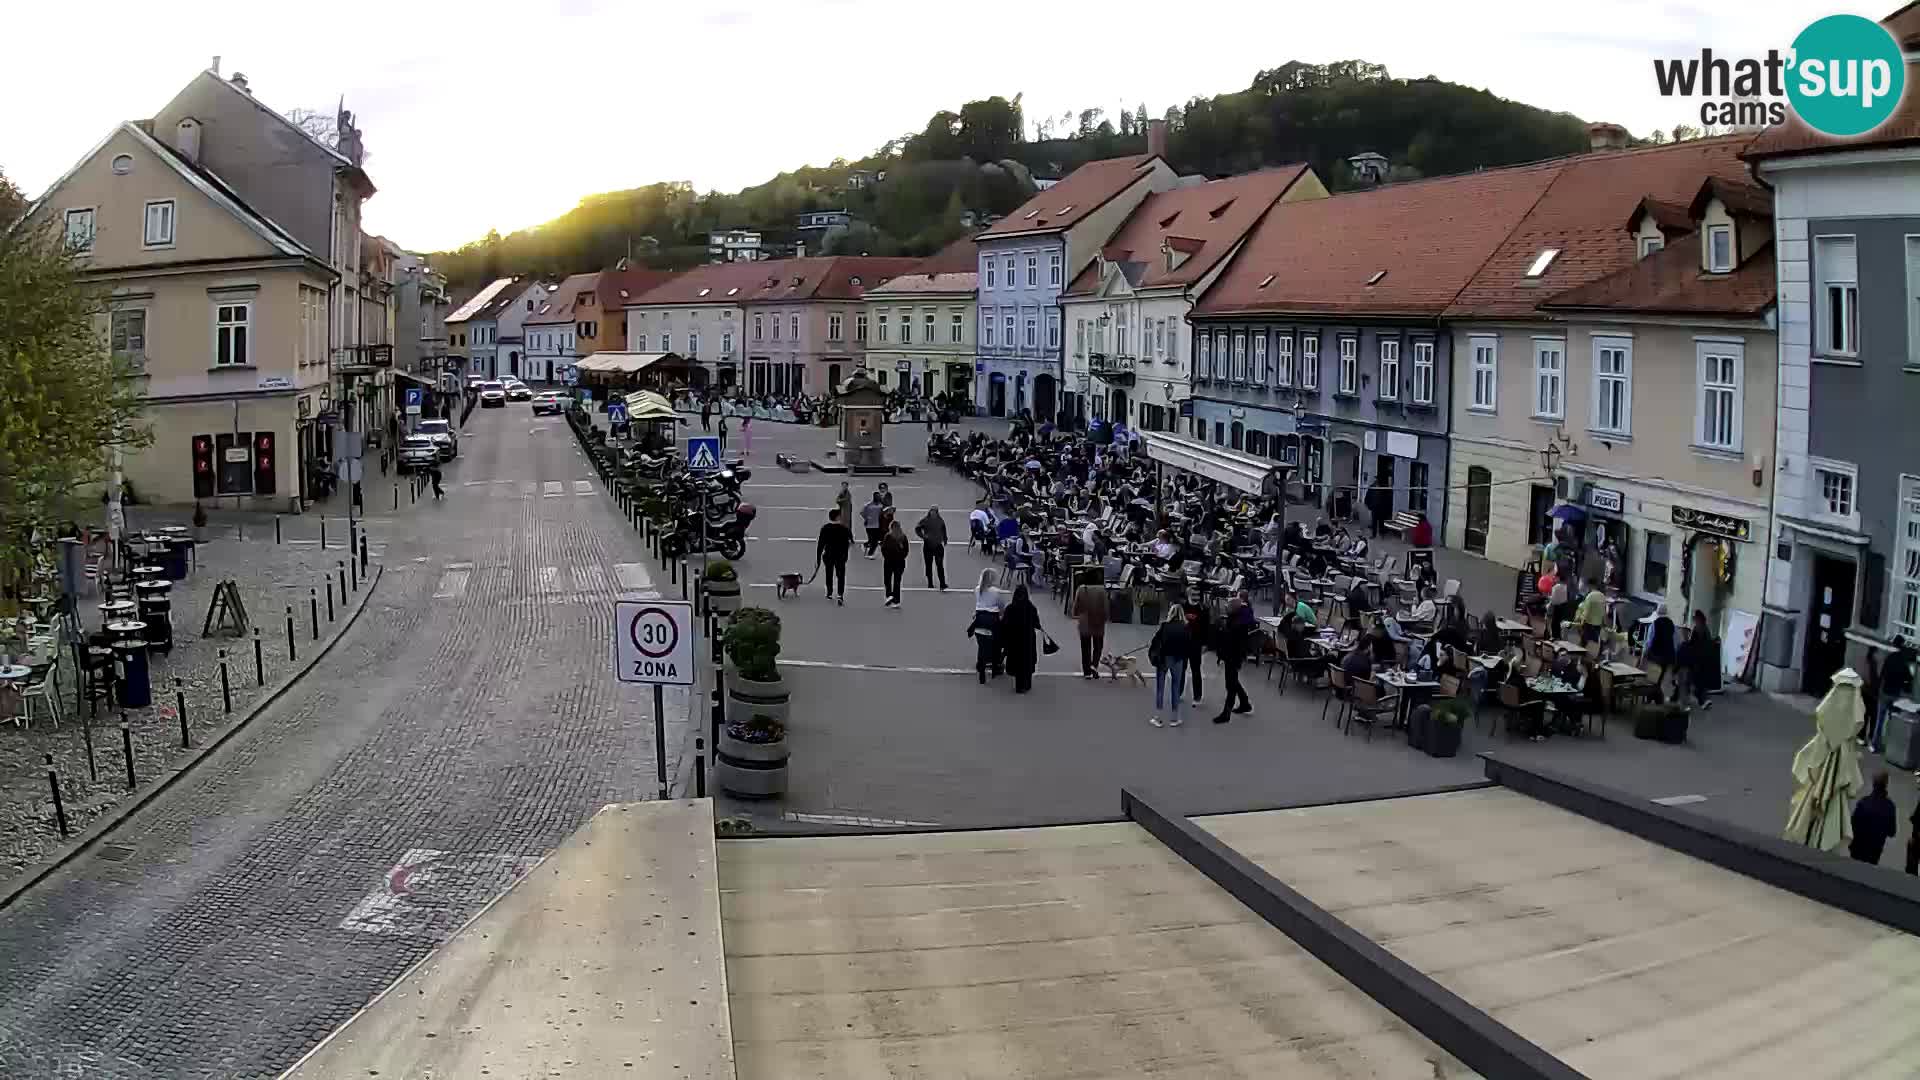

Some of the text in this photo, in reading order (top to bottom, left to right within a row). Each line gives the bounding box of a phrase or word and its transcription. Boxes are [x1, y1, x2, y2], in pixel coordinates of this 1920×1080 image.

[409, 391, 418, 404] P
[643, 623, 667, 645] 30
[633, 660, 678, 678] ZONA
